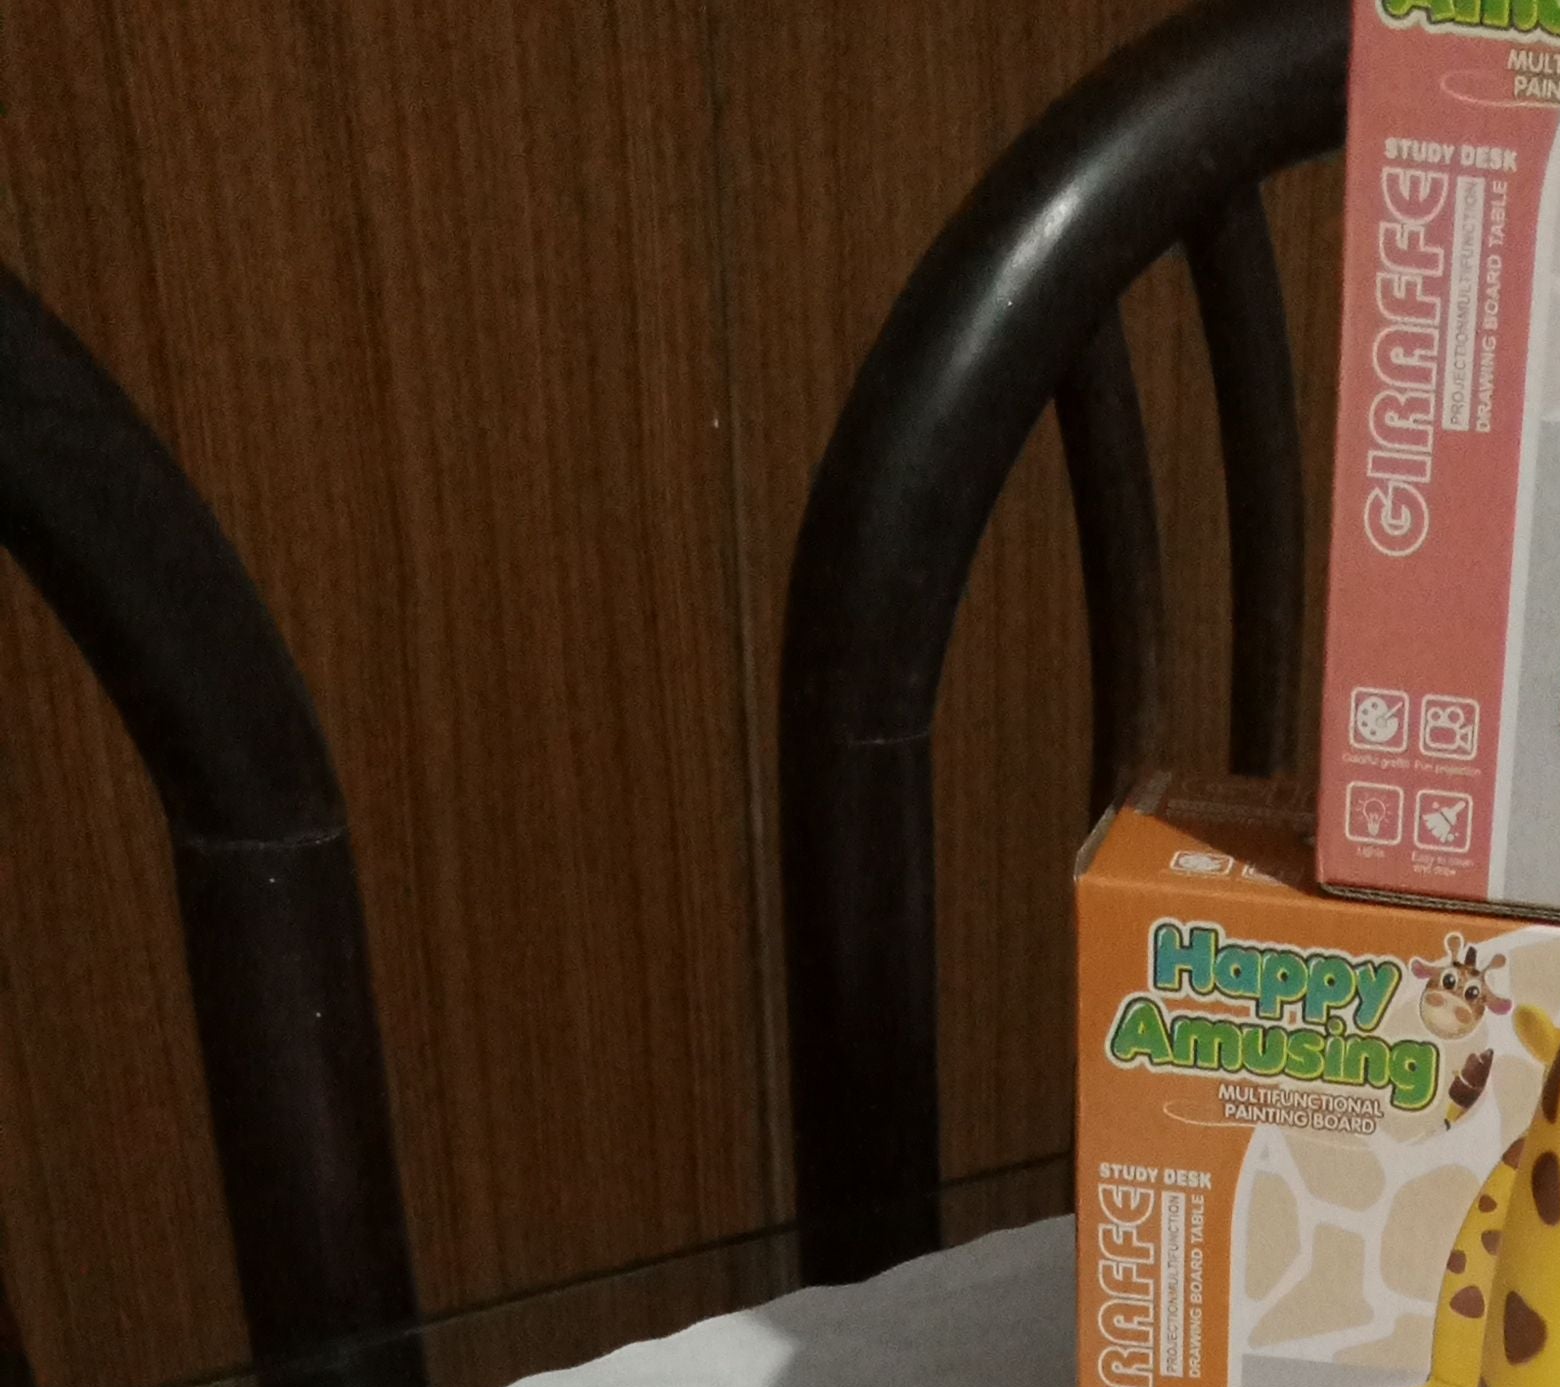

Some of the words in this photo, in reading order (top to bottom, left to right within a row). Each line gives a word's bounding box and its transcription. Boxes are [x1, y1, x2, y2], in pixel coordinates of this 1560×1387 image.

[1385, 138, 1453, 165] STUDY
[1460, 143, 1518, 170] DESK
[1487, 179, 1508, 247] TABLE
[1482, 255, 1501, 330] BOARD
[1363, 167, 1449, 556] GIRAFFE
[1477, 337, 1498, 432] DRAWING
[1152, 923, 1402, 1033] Happy
[1110, 994, 1441, 1108] Amusing
[1218, 1083, 1384, 1118] MULTIFUNCTIONAL
[1224, 1103, 1310, 1128] PAINTING
[1312, 1110, 1377, 1135] BOARD
[1100, 1162, 1158, 1183] STUDY
[1164, 1168, 1211, 1190] DESK
[1191, 1194, 1205, 1244] TABLE
[1190, 1249, 1204, 1304] BOARD
[1189, 1308, 1203, 1378] DRAWING
